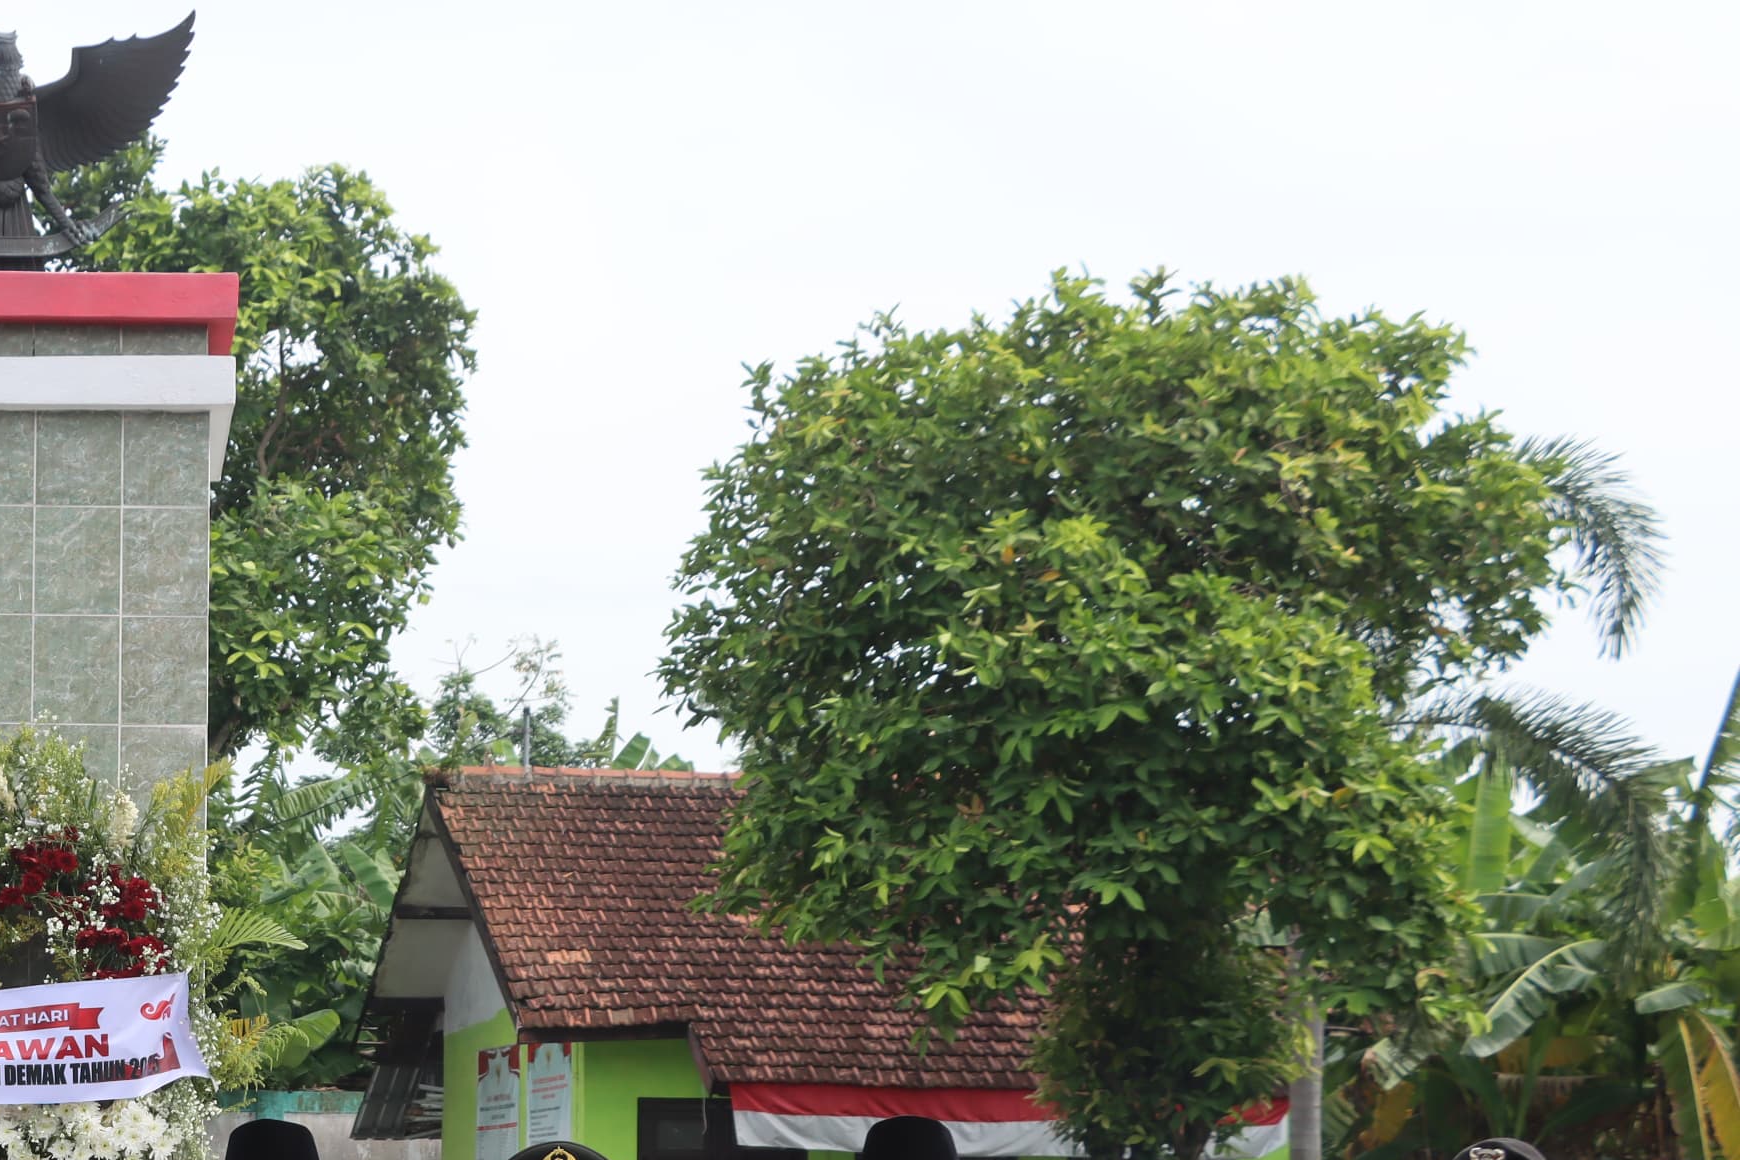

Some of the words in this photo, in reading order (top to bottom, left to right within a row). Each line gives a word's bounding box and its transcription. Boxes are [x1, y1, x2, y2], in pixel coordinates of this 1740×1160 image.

[24, 1007, 69, 1025] HARI
[4, 1063, 67, 1086] DEMAK
[70, 1059, 126, 1084] TAHUN
